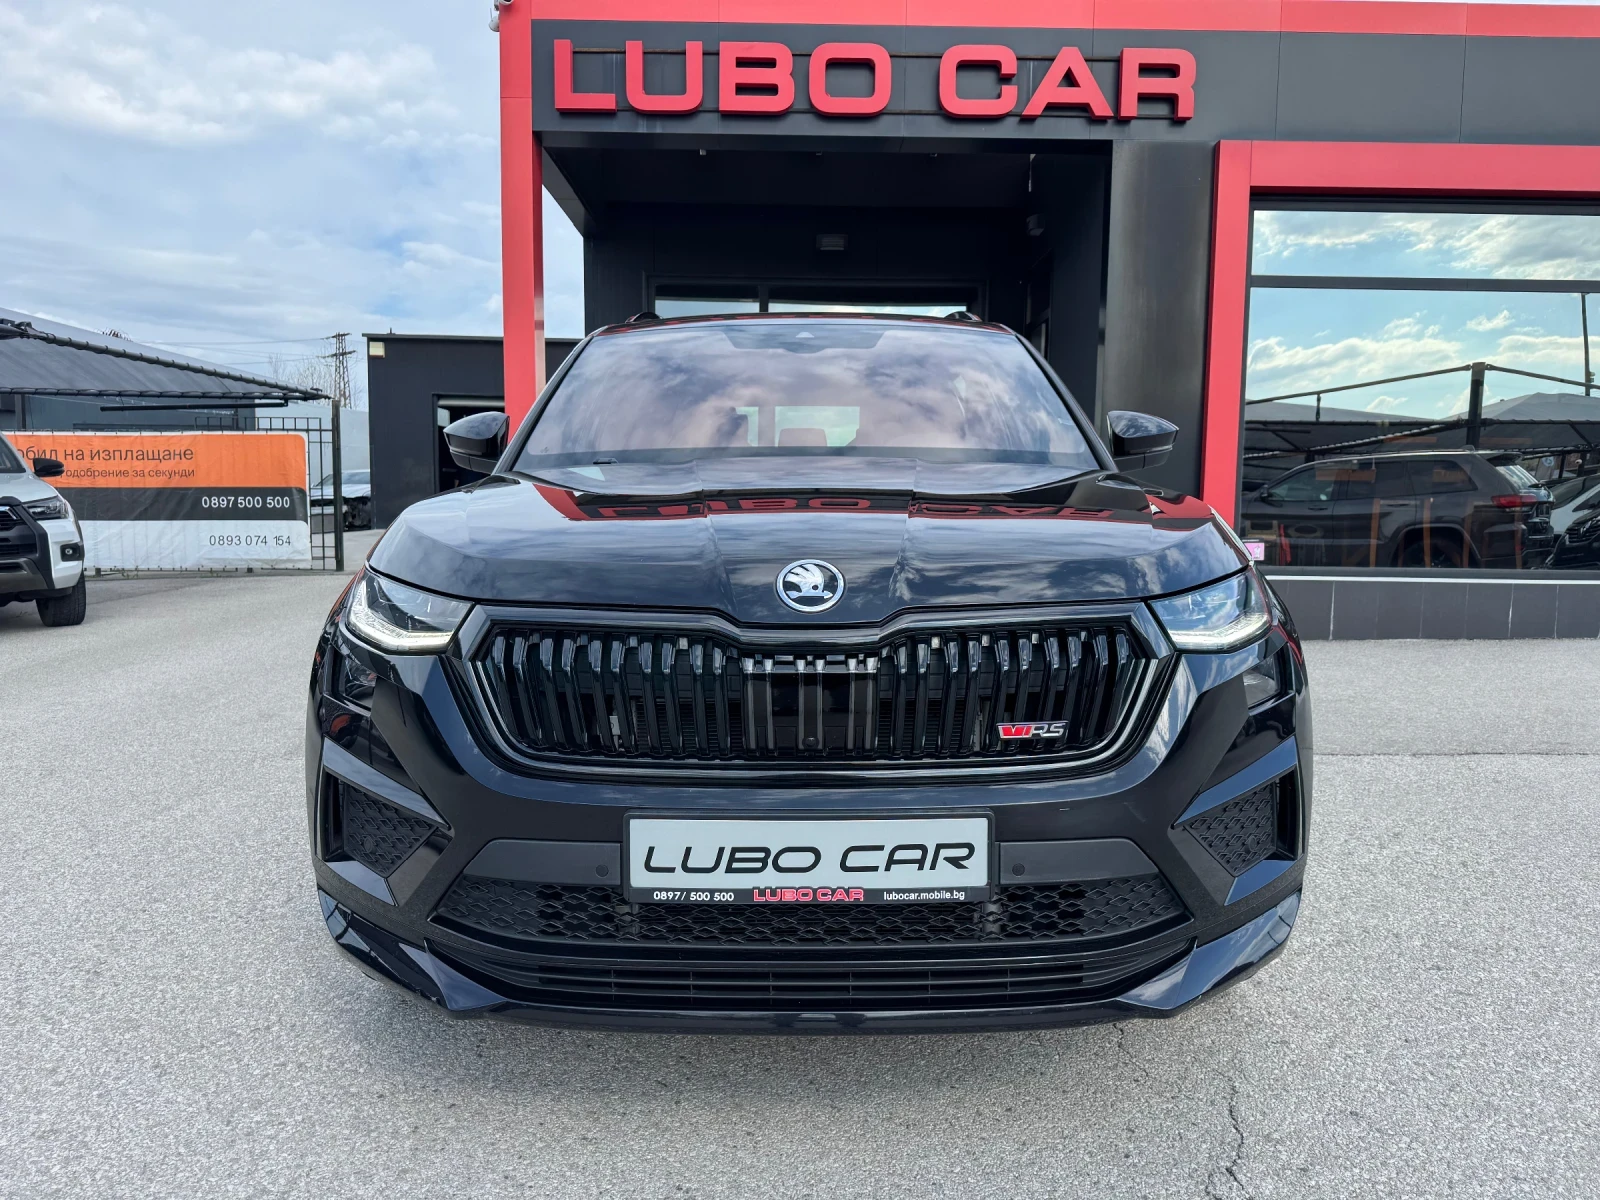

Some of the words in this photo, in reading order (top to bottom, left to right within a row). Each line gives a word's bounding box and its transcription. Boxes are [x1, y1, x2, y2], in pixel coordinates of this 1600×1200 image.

[553, 38, 893, 118] LUBO
[938, 44, 1198, 122] CAR
[64, 449, 85, 461] на
[90, 449, 195, 463] изплащане
[132, 469, 145, 477] за
[148, 468, 195, 478] секунди
[201, 496, 235, 508] 0897
[237, 496, 263, 508] 500
[266, 496, 290, 508] 500
[209, 535, 242, 546] 0893
[245, 535, 268, 546] 074
[273, 535, 292, 546] 154
[643, 845, 822, 874] LUBO
[839, 842, 975, 873] CAR
[653, 891, 687, 900] 0897/
[689, 892, 710, 901] 500
[713, 892, 735, 901] 500
[753, 888, 813, 902] LUBO
[816, 888, 865, 902] CAR
[883, 890, 965, 901] lubocar.mobile.bg
